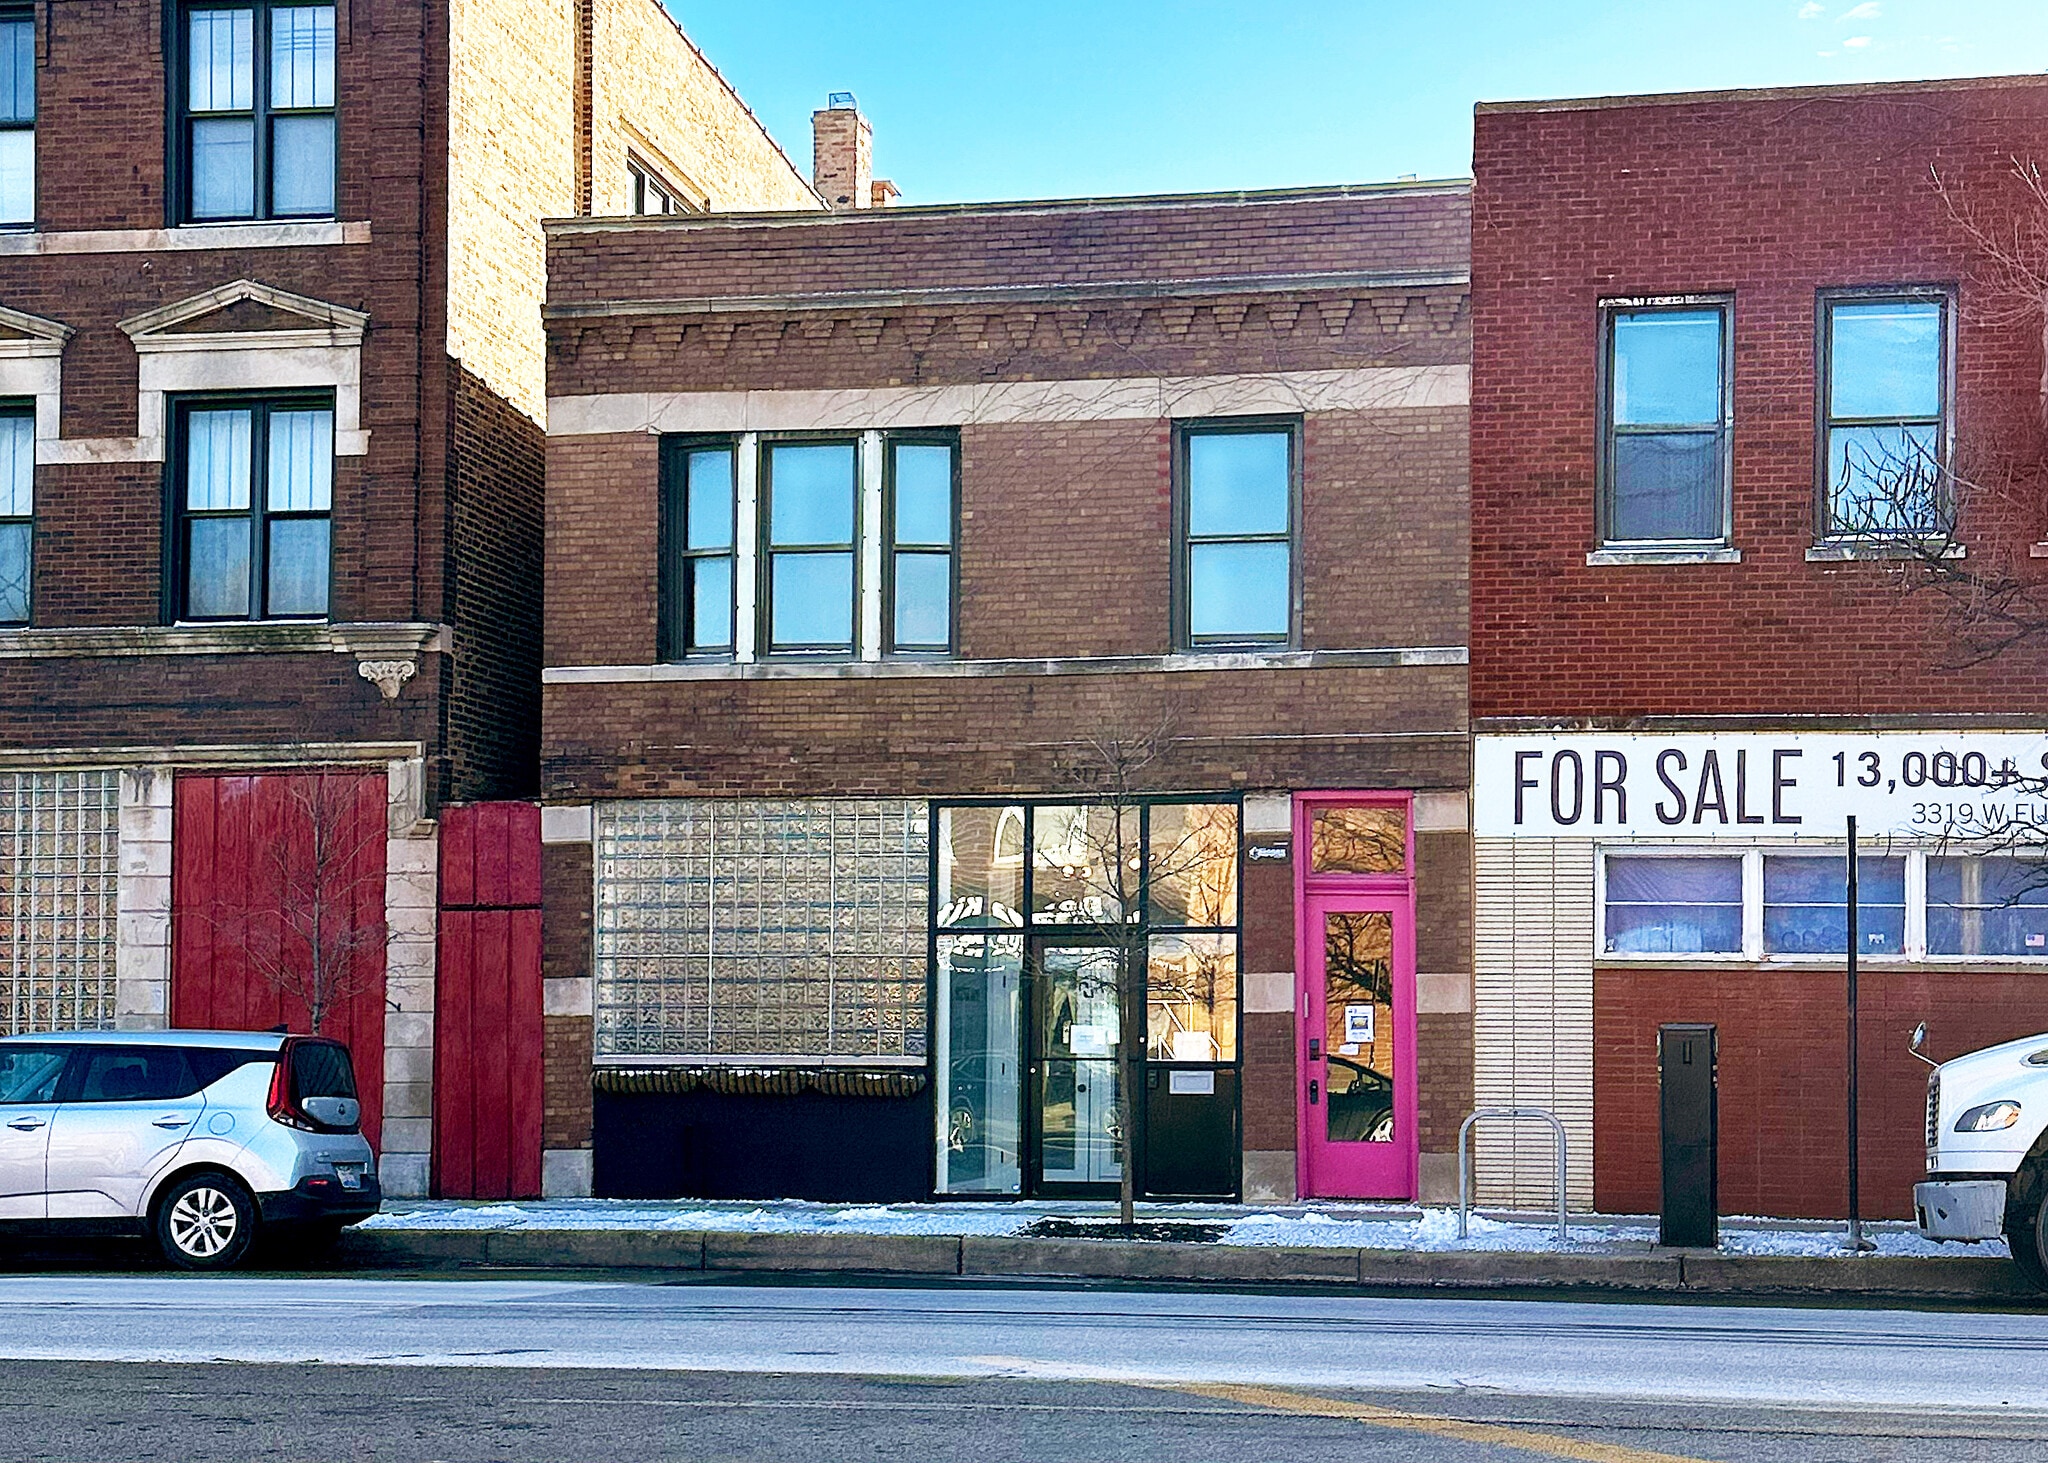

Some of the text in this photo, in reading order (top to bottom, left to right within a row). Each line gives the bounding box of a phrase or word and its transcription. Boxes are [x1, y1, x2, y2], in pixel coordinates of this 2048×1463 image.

[1513, 748, 1803, 825] FOR SALE
[1832, 751, 2019, 794] 13,000+
[1911, 802, 1974, 825] 3319
[1982, 803, 2006, 825] W
